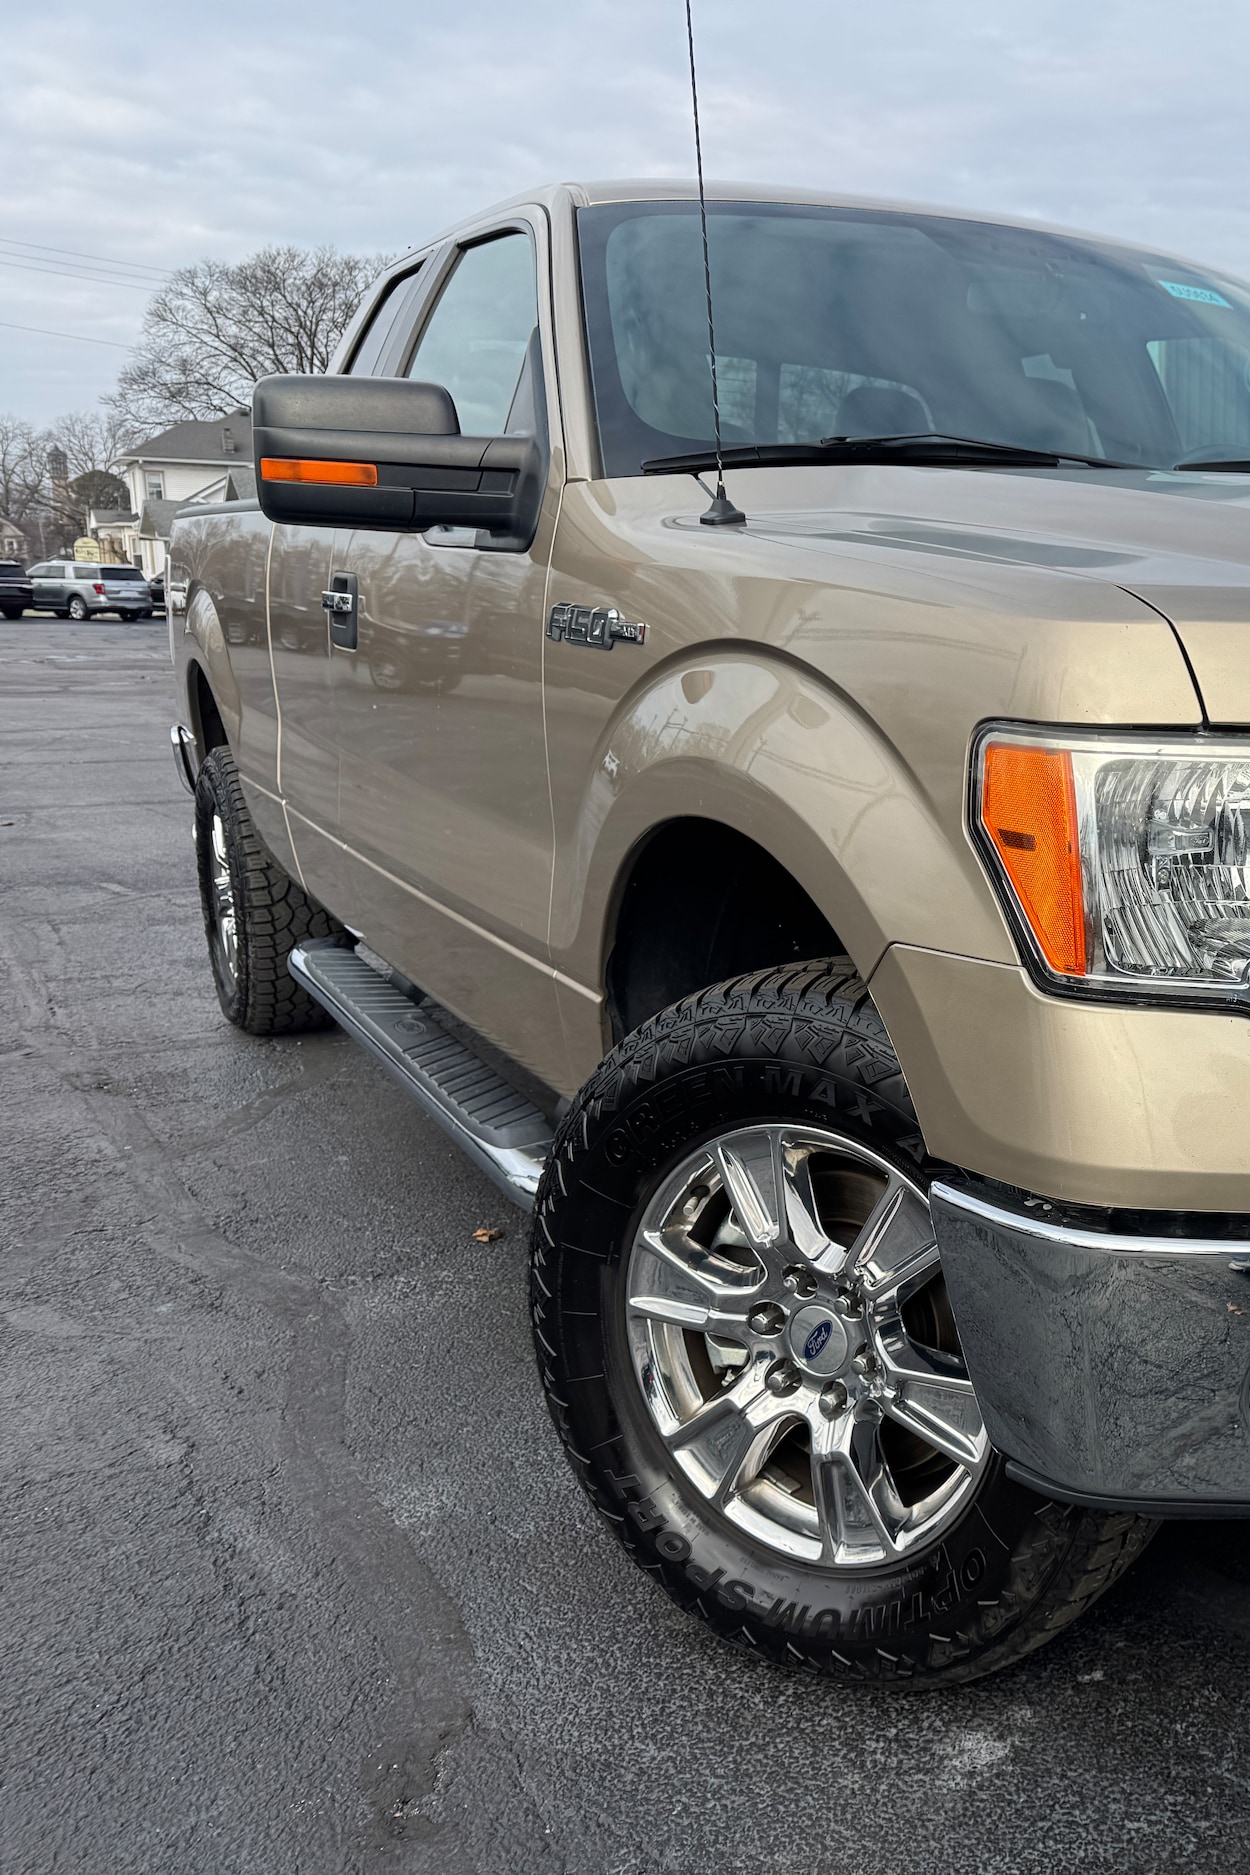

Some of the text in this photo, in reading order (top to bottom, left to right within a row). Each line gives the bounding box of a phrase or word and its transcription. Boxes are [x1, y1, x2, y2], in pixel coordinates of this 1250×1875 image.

[603, 1065, 745, 1168] GREEN
[762, 1065, 886, 1127] MAX
[807, 1326, 828, 1356] Ford
[604, 1468, 987, 1642] OPTIMUM SPORT
